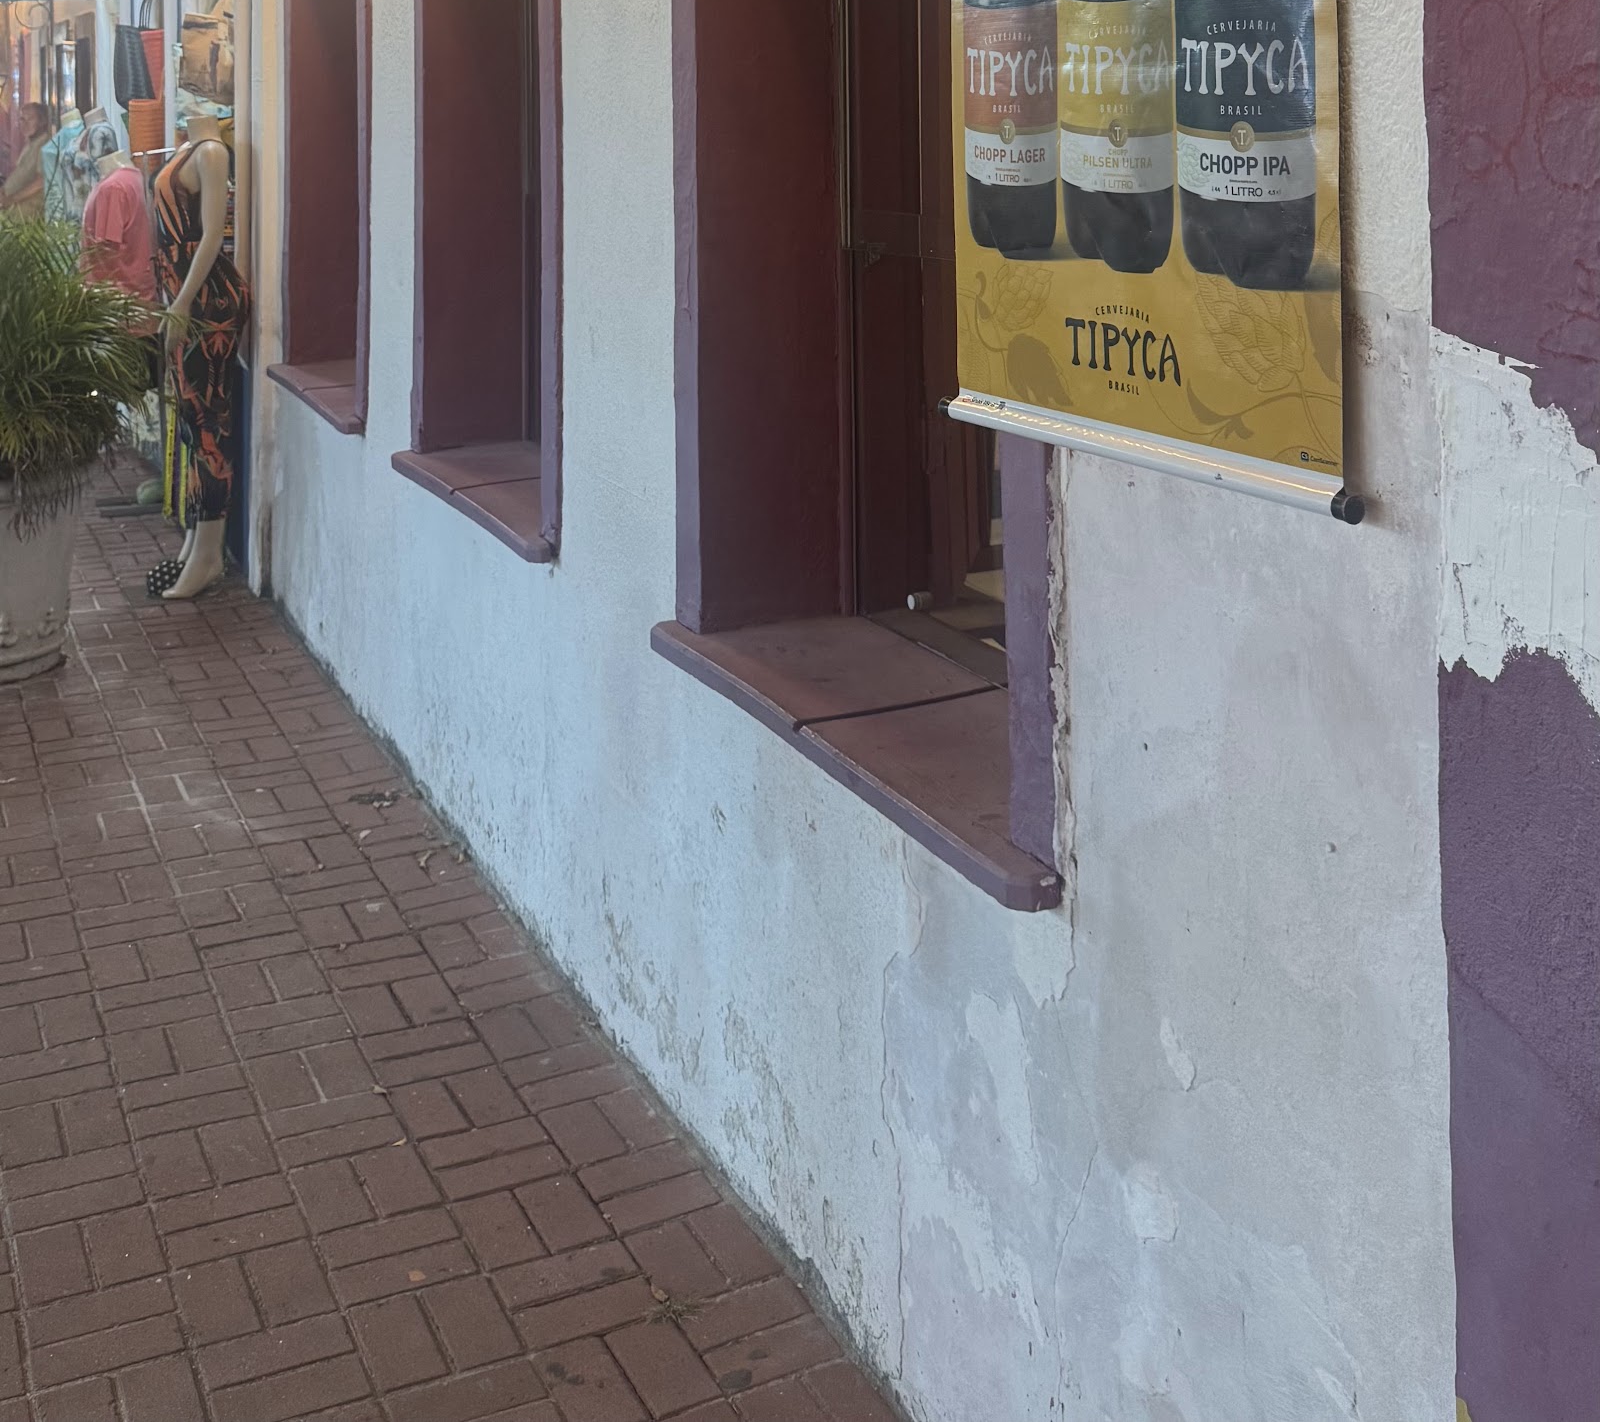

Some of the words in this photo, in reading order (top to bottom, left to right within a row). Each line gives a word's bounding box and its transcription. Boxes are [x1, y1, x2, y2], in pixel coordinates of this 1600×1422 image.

[1206, 20, 1276, 35] CERVEJARIA
[967, 46, 1054, 96] TIPYCA
[1065, 39, 1169, 95] TIPYCA
[1181, 37, 1309, 95] TIPYCA
[993, 104, 1021, 113] BRASIL
[1220, 105, 1262, 115] BRASIL
[974, 145, 1007, 162] CHOPP
[1010, 148, 1046, 163] LAGER
[1083, 155, 1119, 168] PILSEN
[1122, 158, 1153, 169] ULTRA
[1200, 153, 1259, 175] CHOPP
[1263, 156, 1290, 176] IPA
[1000, 174, 1020, 183] LITRO
[1108, 179, 1133, 189] LITRO
[1231, 186, 1263, 196] LITRO
[1095, 305, 1150, 323] CERVEJARIA
[1065, 317, 1181, 387] TIPYCA
[1108, 380, 1140, 395] BRASIL
